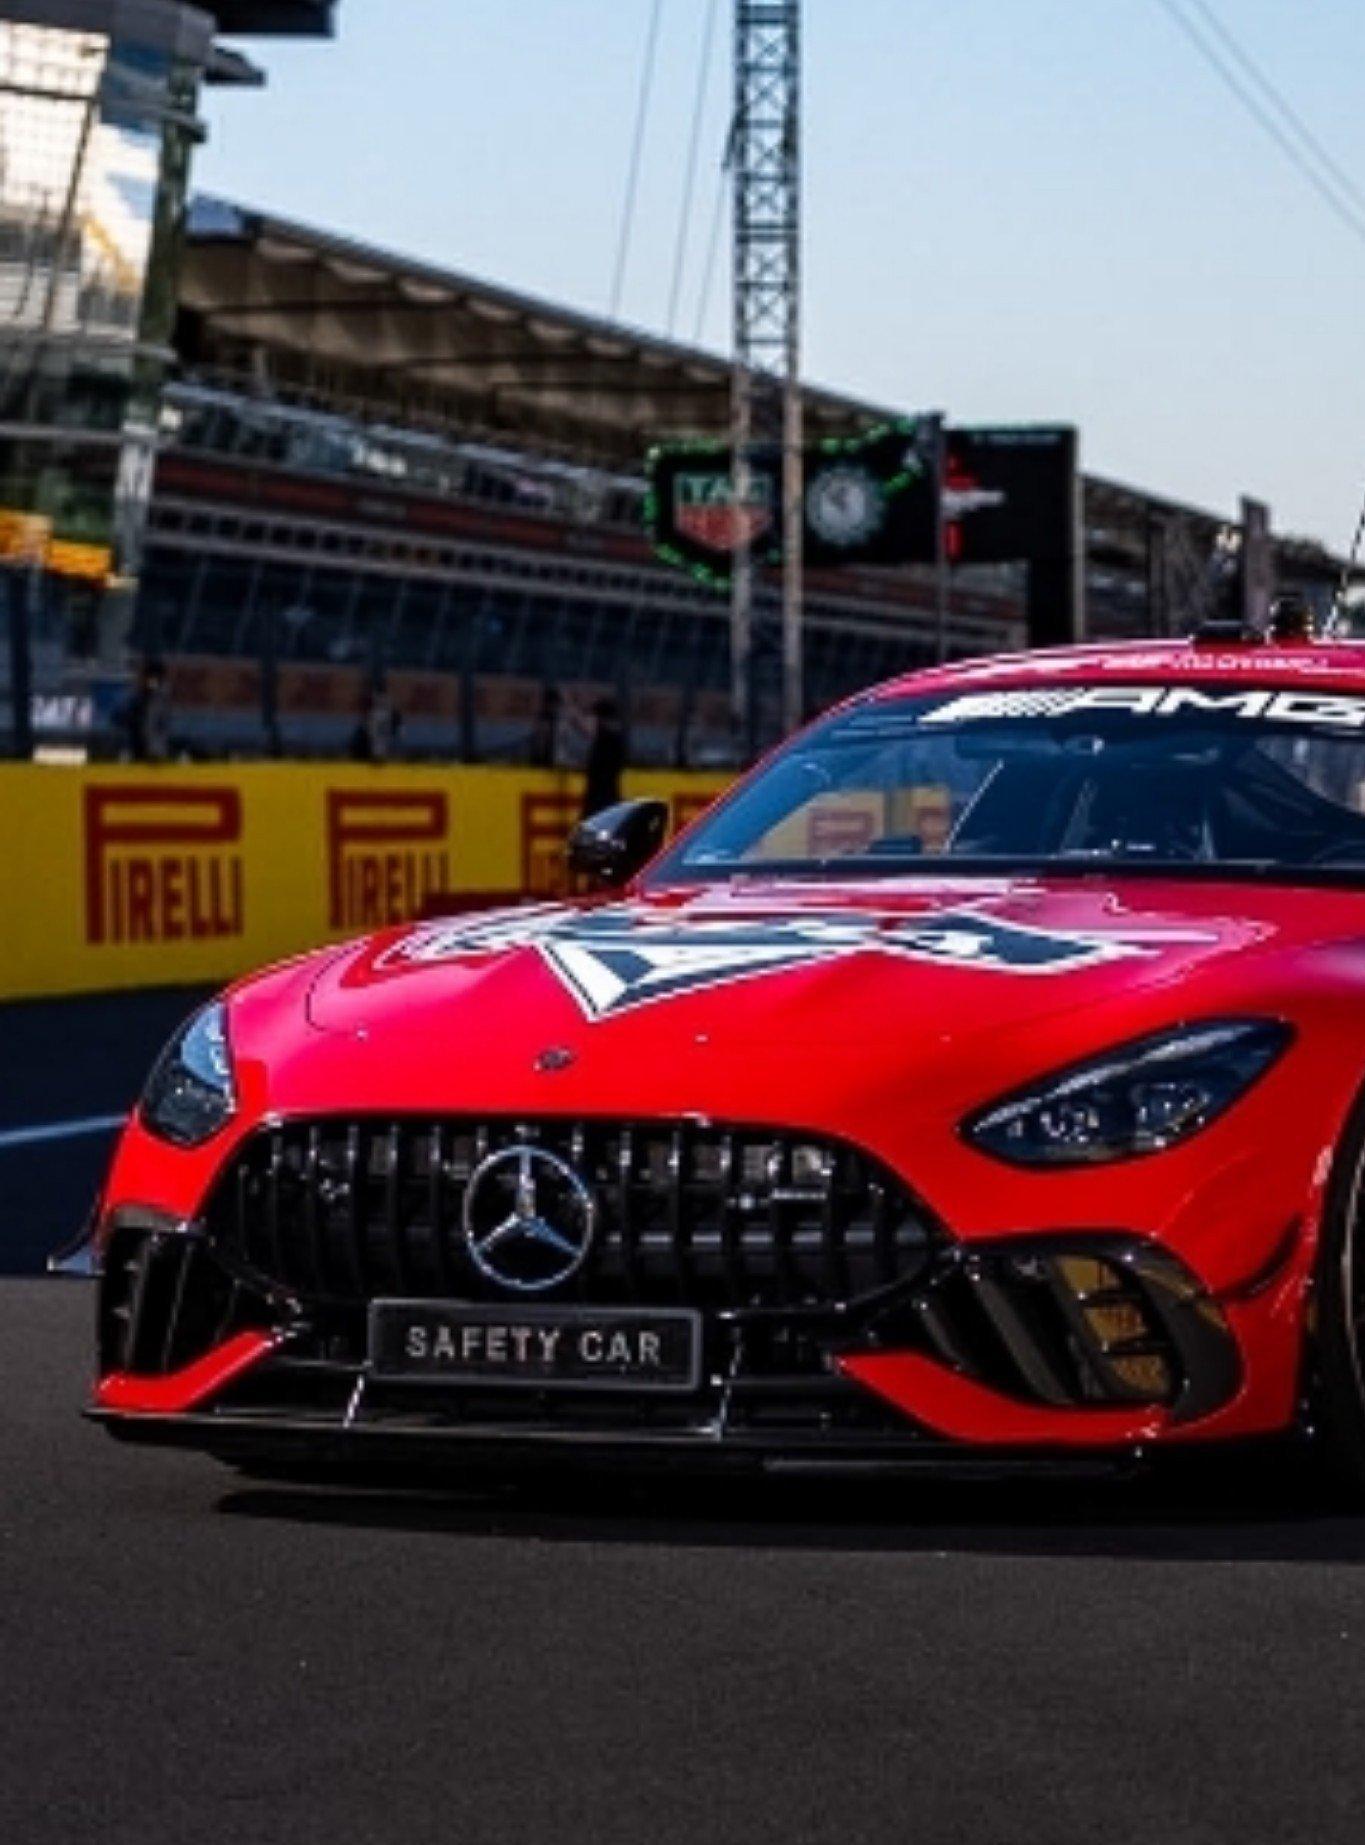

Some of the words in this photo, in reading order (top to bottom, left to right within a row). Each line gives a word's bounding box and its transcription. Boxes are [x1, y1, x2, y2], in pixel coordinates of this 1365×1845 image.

[84, 785, 241, 945] PIRELLI
[405, 1324, 560, 1362] SAFETY
[580, 1330, 661, 1366] CAR
